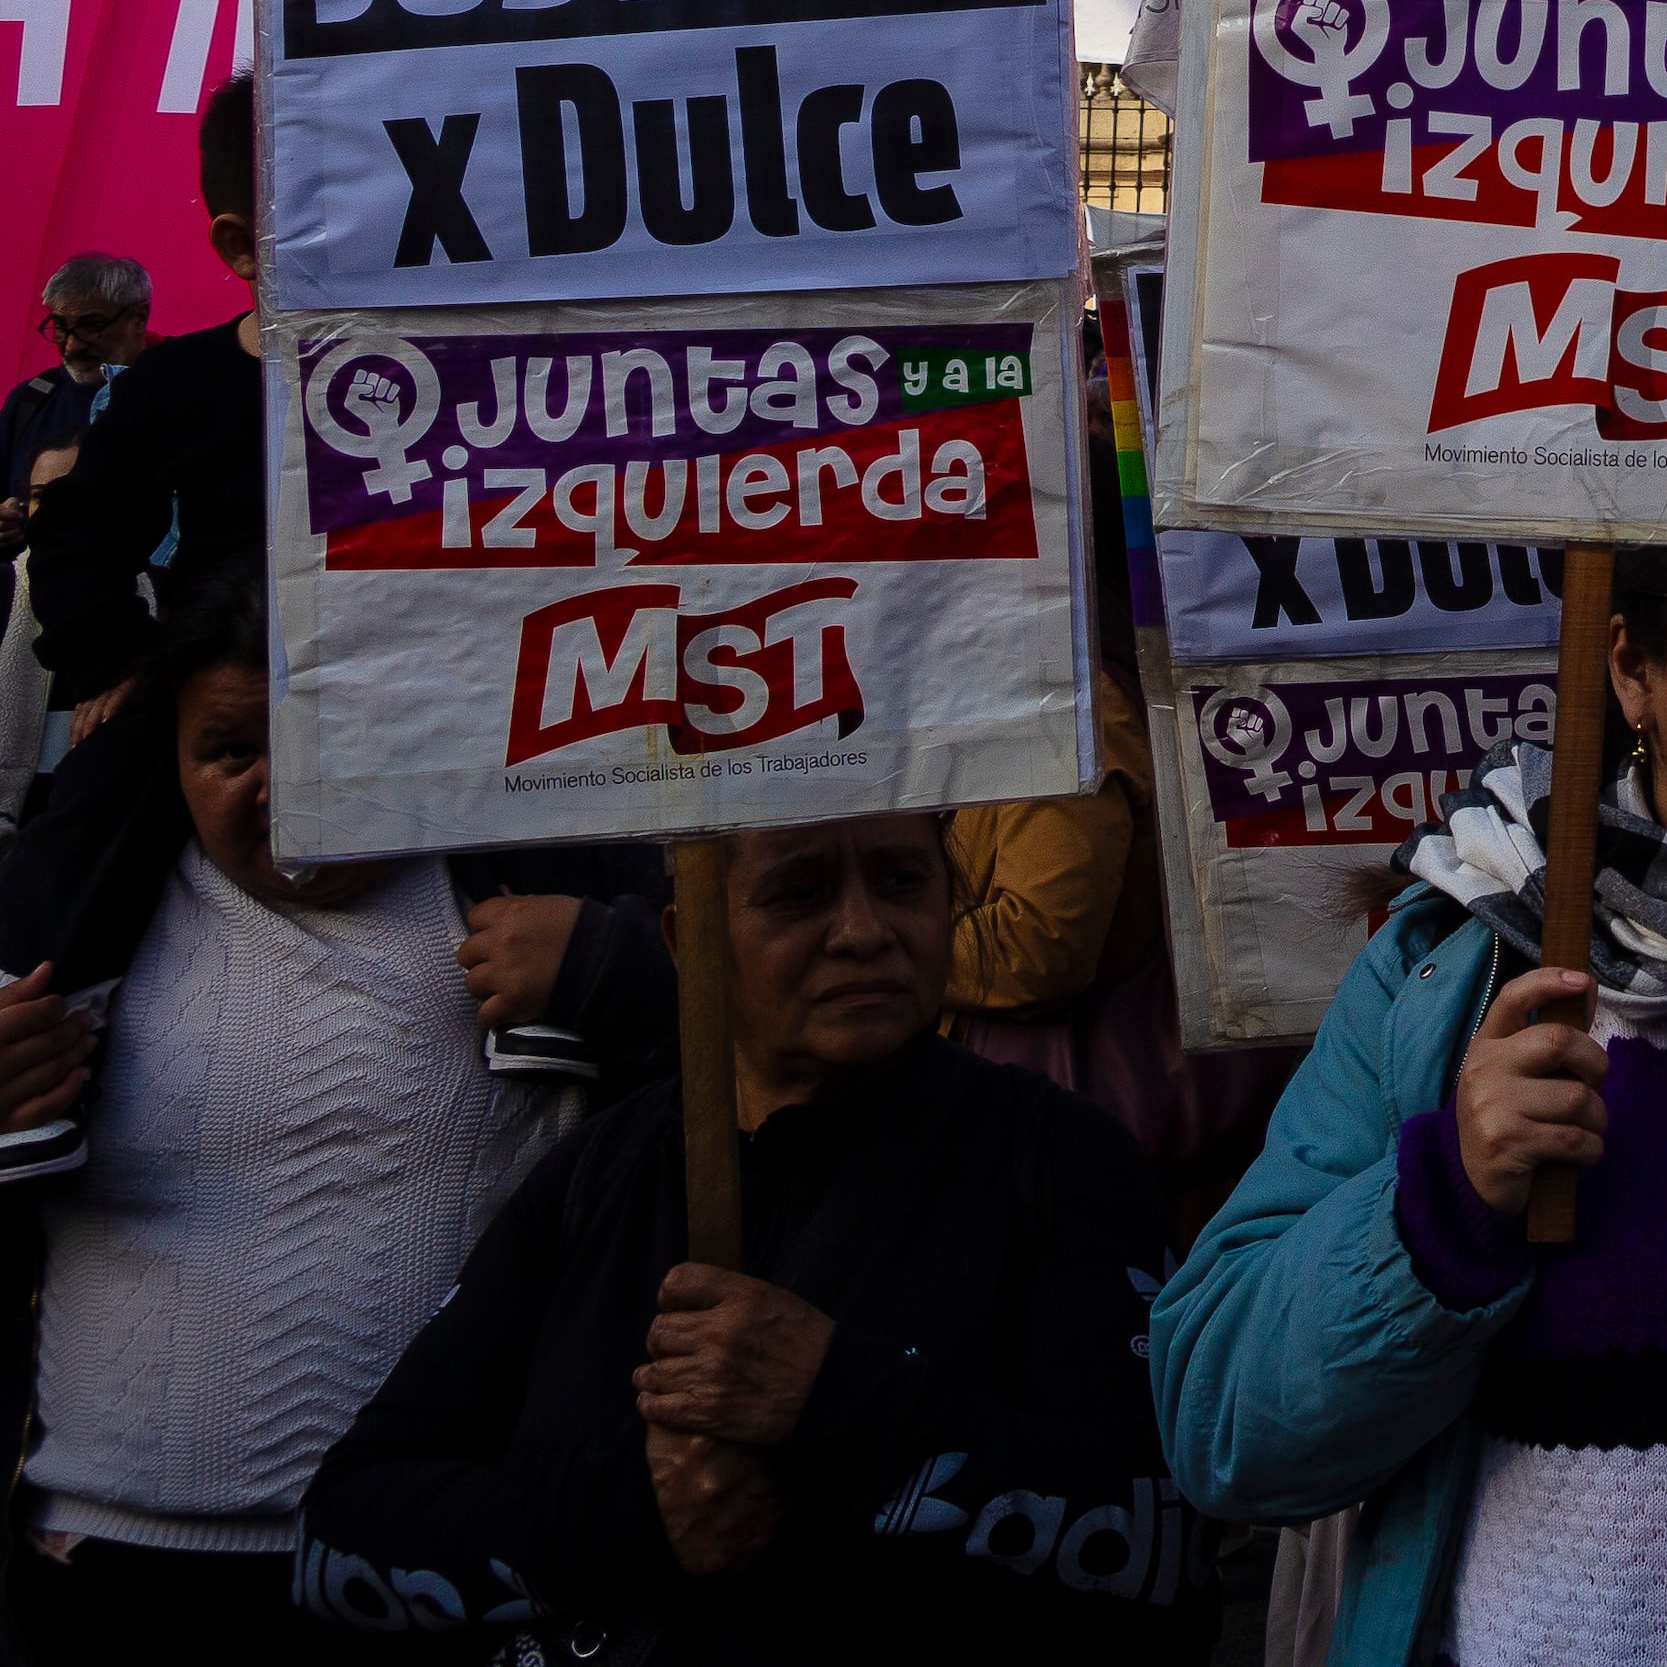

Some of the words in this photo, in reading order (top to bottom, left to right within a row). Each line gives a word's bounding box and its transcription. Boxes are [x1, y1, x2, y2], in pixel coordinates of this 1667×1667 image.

[383, 113, 492, 267] x
[514, 44, 964, 257] Dulce
[901, 356, 931, 397] y
[943, 358, 970, 394] a
[984, 353, 1026, 392] la
[1424, 442, 1528, 465] Movimiento
[1534, 446, 1620, 468] Socialista
[1625, 449, 1648, 469] de
[441, 428, 987, 567] izquierda
[538, 596, 858, 735] MST
[1306, 684, 1556, 763] junta
[505, 772, 607, 794] Movimiento
[611, 764, 696, 784] Socialista
[700, 760, 723, 779] de
[727, 758, 753, 776] los
[756, 749, 869, 775] Trabajadores
